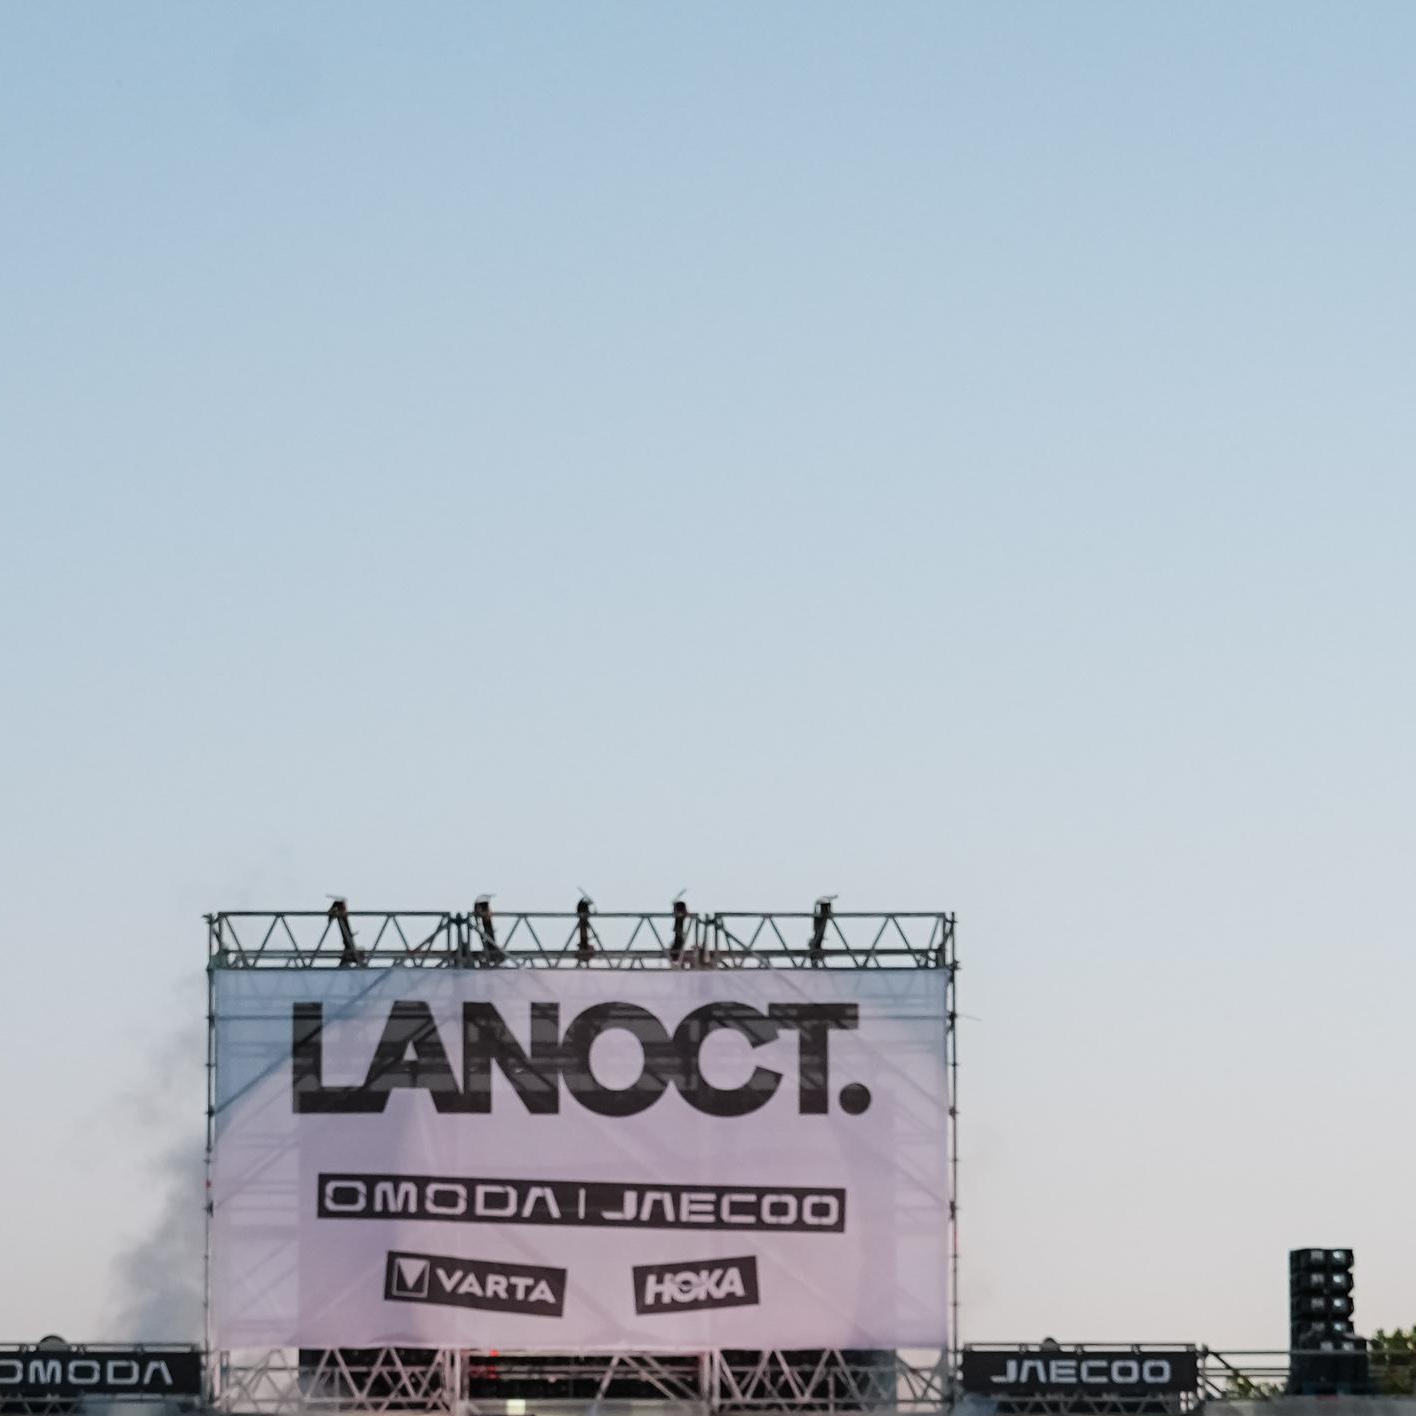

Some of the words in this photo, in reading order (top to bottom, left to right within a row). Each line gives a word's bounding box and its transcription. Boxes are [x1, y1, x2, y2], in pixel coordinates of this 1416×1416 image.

[292, 1001, 873, 1118] LANOCT.
[323, 1179, 561, 1218] OMODA
[602, 1189, 840, 1226] JAECOO
[435, 1267, 557, 1305] VARTA
[644, 1265, 747, 1303] HOKA
[989, 1358, 1172, 1385] JAECOO
